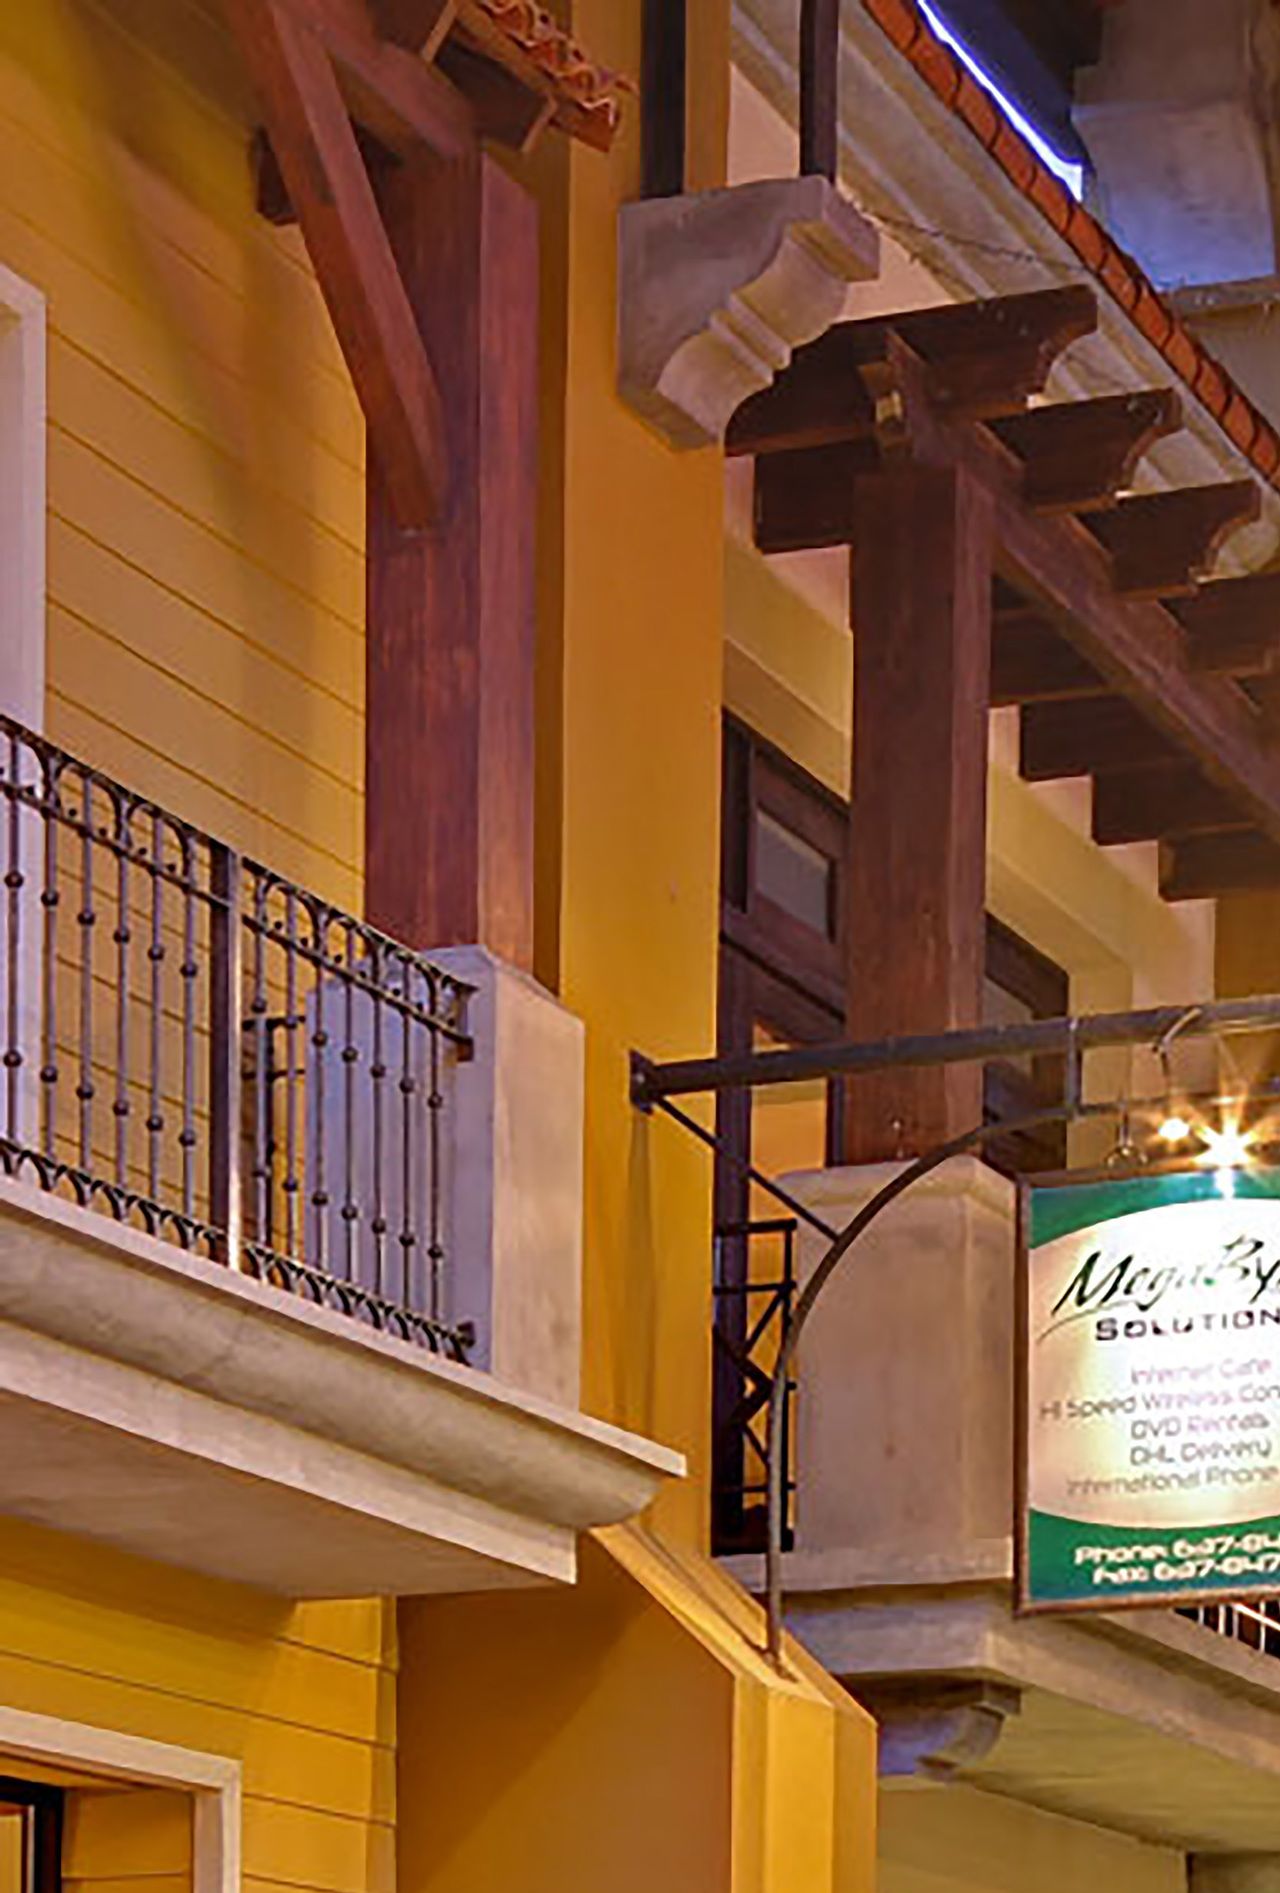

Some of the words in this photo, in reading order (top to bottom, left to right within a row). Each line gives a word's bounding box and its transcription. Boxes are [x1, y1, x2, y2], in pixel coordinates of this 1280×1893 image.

[1130, 1362, 1214, 1386] Internet
[1067, 1394, 1137, 1419] Speed
[1141, 1386, 1234, 1411] Wireless
[1130, 1415, 1182, 1440] DVD
[1186, 1410, 1271, 1433] Rentals
[1130, 1444, 1175, 1466] DHL
[1180, 1438, 1274, 1463] Delivery
[1065, 1466, 1201, 1497] International
[1205, 1459, 1280, 1486] Phone
